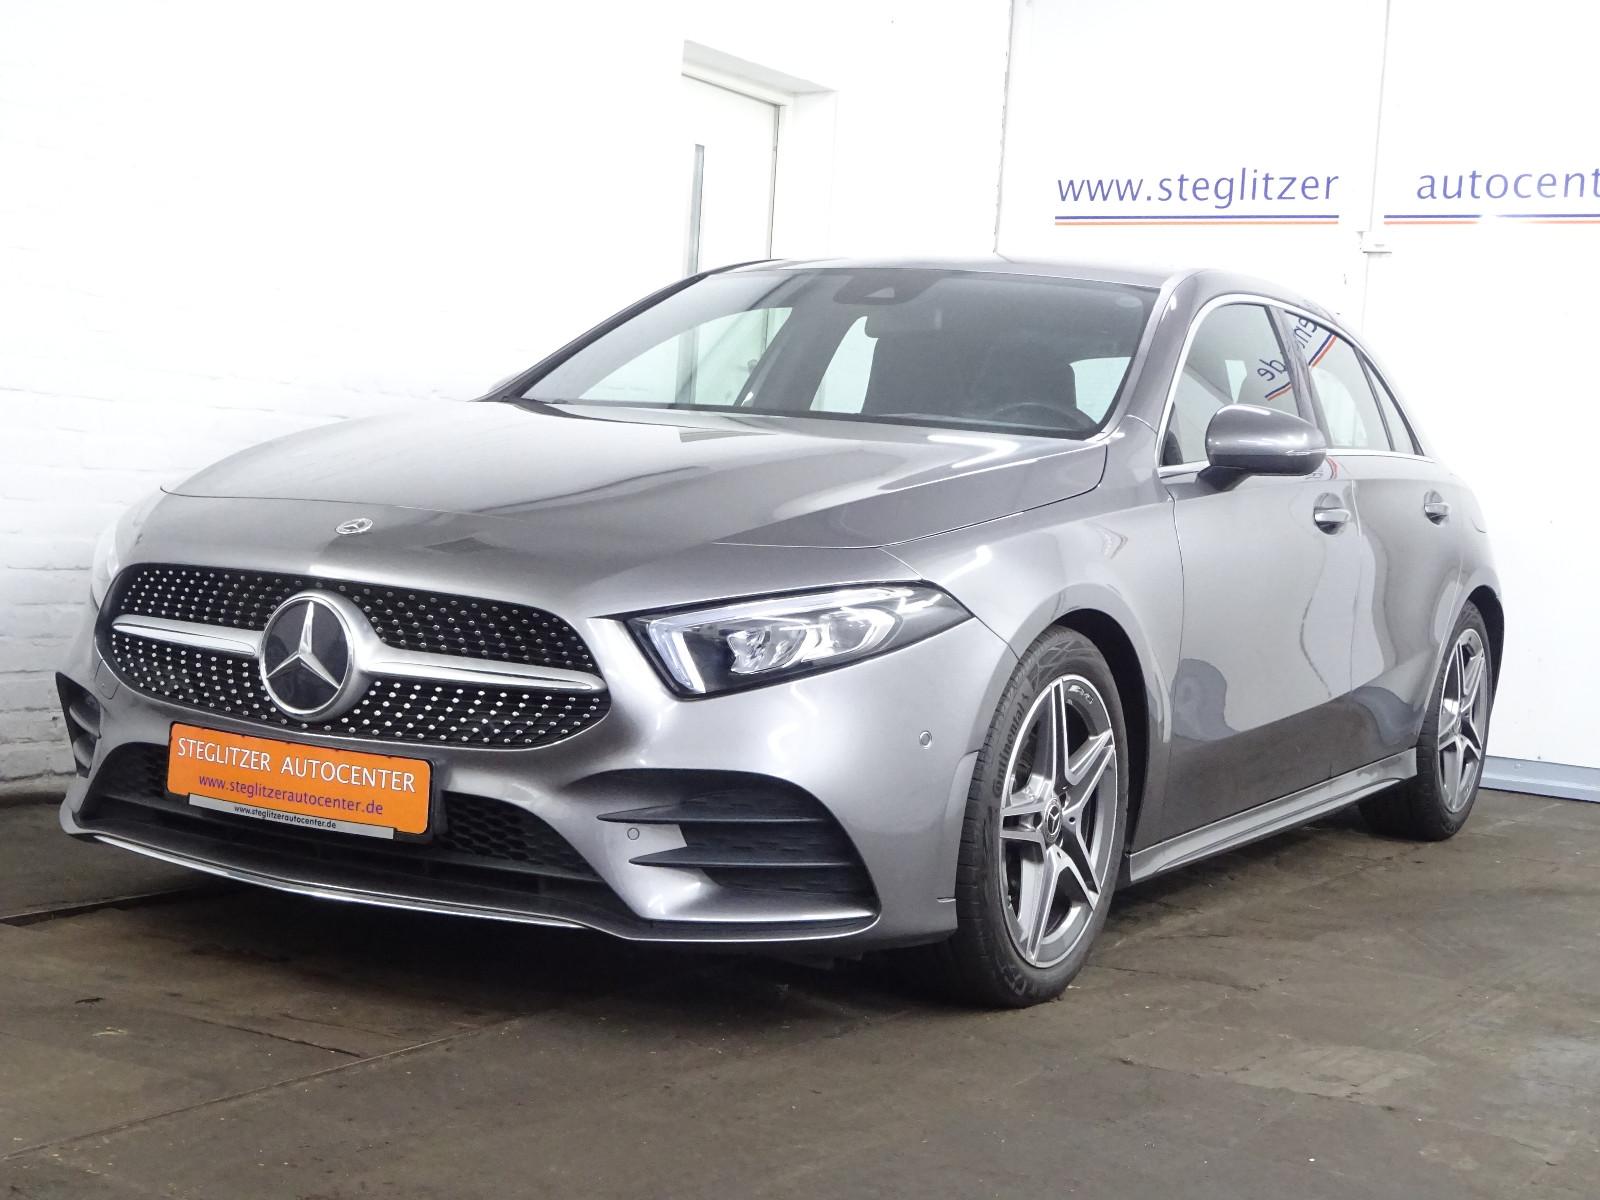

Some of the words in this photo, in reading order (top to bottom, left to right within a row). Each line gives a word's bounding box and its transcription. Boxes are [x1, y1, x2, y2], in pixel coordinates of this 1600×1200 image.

[1057, 168, 1339, 209] www.steglitzer
[1416, 168, 1600, 200] autocent
[177, 737, 272, 773] STEGLITZER
[280, 755, 416, 793] AUTOCENTER
[198, 775, 384, 816] www.steglitzerautocenter.de
[233, 804, 337, 829] www.steglitzerautocenter.de
